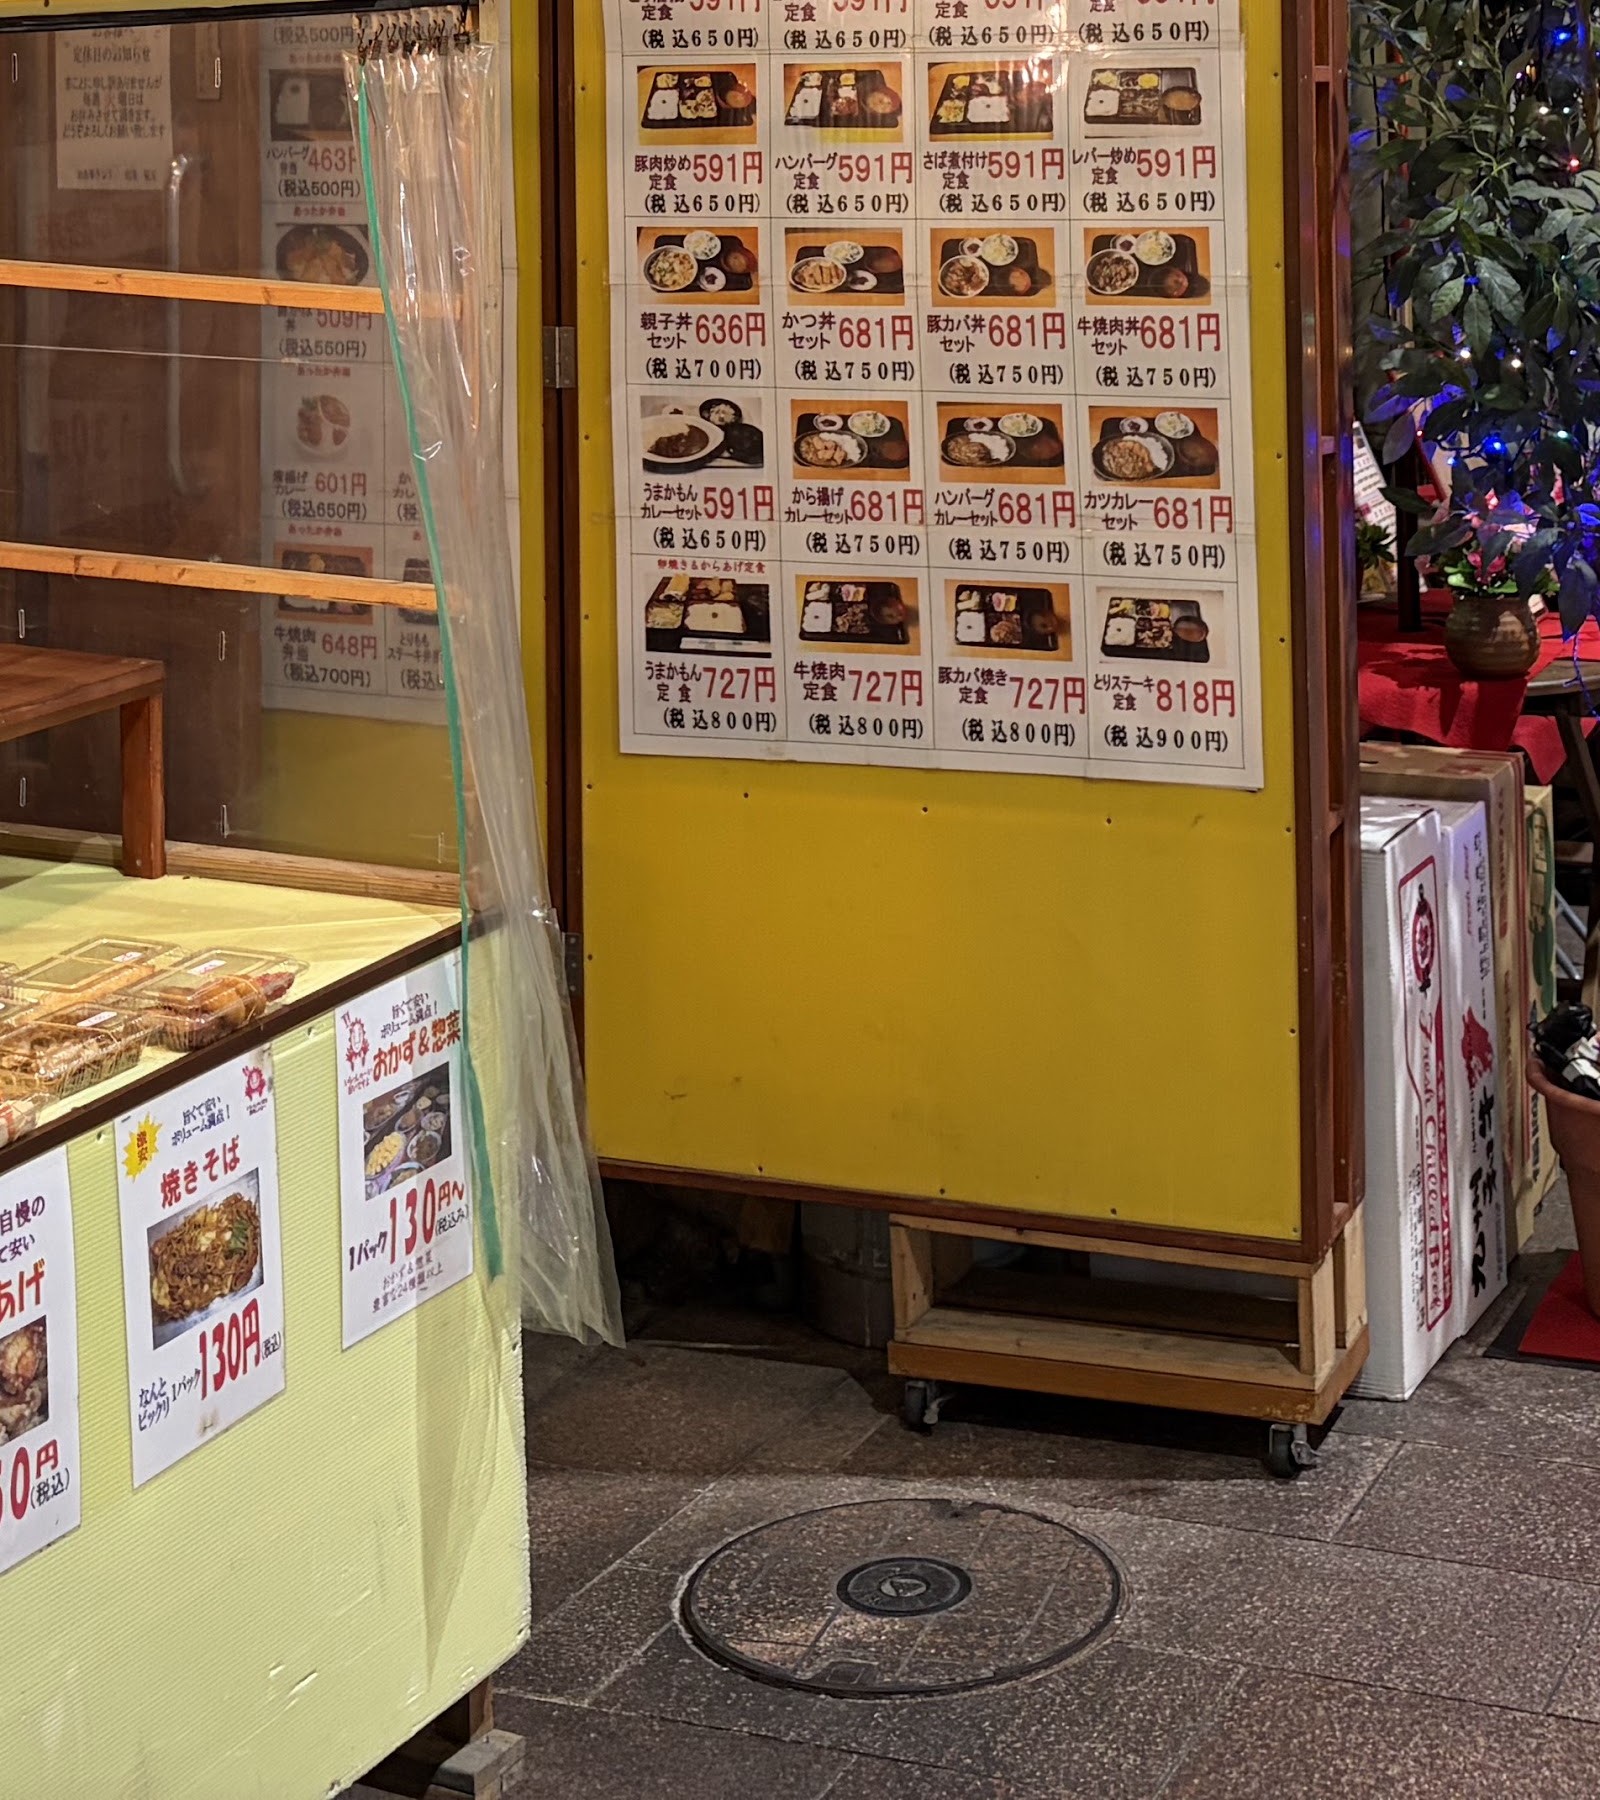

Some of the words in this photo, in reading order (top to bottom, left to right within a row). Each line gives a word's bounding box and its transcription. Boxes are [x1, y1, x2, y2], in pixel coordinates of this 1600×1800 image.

[642, 4, 673, 21] 定食
[784, 4, 816, 22] 定食
[935, 2, 968, 19] 定食
[634, 154, 691, 173] 豚肉炒め
[775, 153, 837, 170] ハンバーグ
[923, 151, 987, 170] さば煮付け
[987, 148, 1064, 180] 591円
[1072, 146, 1137, 165] レバー炒め
[1136, 145, 1216, 179] 591円
[693, 151, 763, 184] 591円
[838, 152, 913, 184] 591円
[649, 174, 677, 191] 定食
[942, 171, 970, 190] 定食
[640, 312, 693, 330] 親子丼
[695, 312, 766, 347] 636円
[782, 311, 836, 331] かつ丼
[988, 312, 1066, 350] 681円
[1077, 316, 1140, 336] 牛焼肉丼
[646, 332, 687, 349] セット
[788, 332, 830, 350] セット
[839, 315, 914, 351] 681円
[1140, 313, 1221, 352] 681円
[1091, 338, 1128, 356] セット
[643, 483, 697, 502] うまかもん
[791, 486, 844, 506] から揚げ
[935, 488, 995, 508] ハンバーグ
[1084, 490, 1154, 510] カツカレー
[640, 503, 703, 520] カレーセット
[703, 485, 774, 522] 591円
[850, 489, 925, 525] 681円
[999, 491, 1076, 528] 681円
[784, 506, 853, 524] カレーセット
[1153, 495, 1233, 534] 681円
[645, 660, 702, 681] うまかもん
[793, 661, 845, 681] 牛焼肉
[656, 683, 692, 703] 定食
[702, 666, 776, 703] 727円
[803, 683, 837, 701] 定食
[848, 670, 923, 706] 727円
[1093, 674, 1156, 693] とりステーキ
[1009, 676, 1086, 715] 727円
[1156, 679, 1235, 718] 818円
[160, 1134, 240, 1208] 焼きそば
[200, 1298, 260, 1400] 130円
